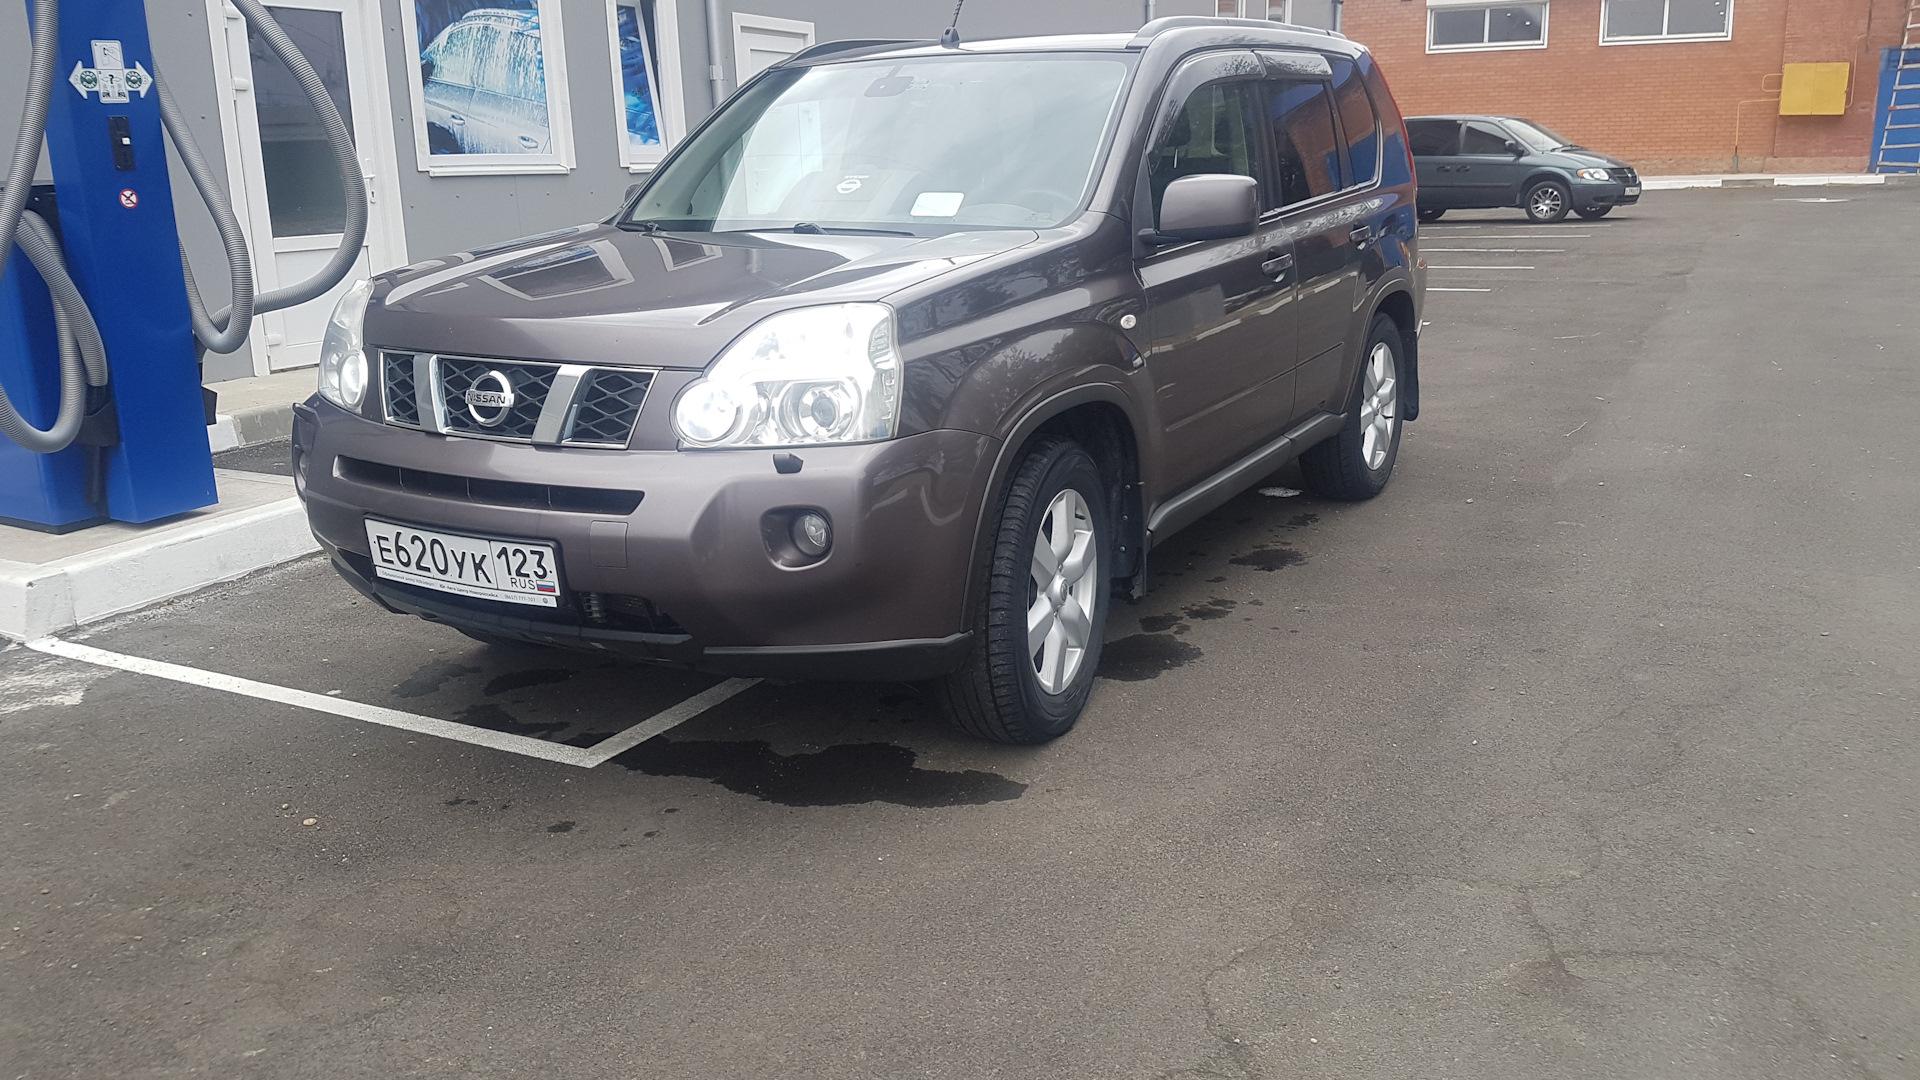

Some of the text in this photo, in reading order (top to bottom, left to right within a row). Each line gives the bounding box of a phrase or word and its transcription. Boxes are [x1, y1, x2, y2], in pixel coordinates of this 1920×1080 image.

[467, 393, 506, 404] NISSAN
[496, 546, 548, 580] 123
[510, 578, 536, 590] RUS
